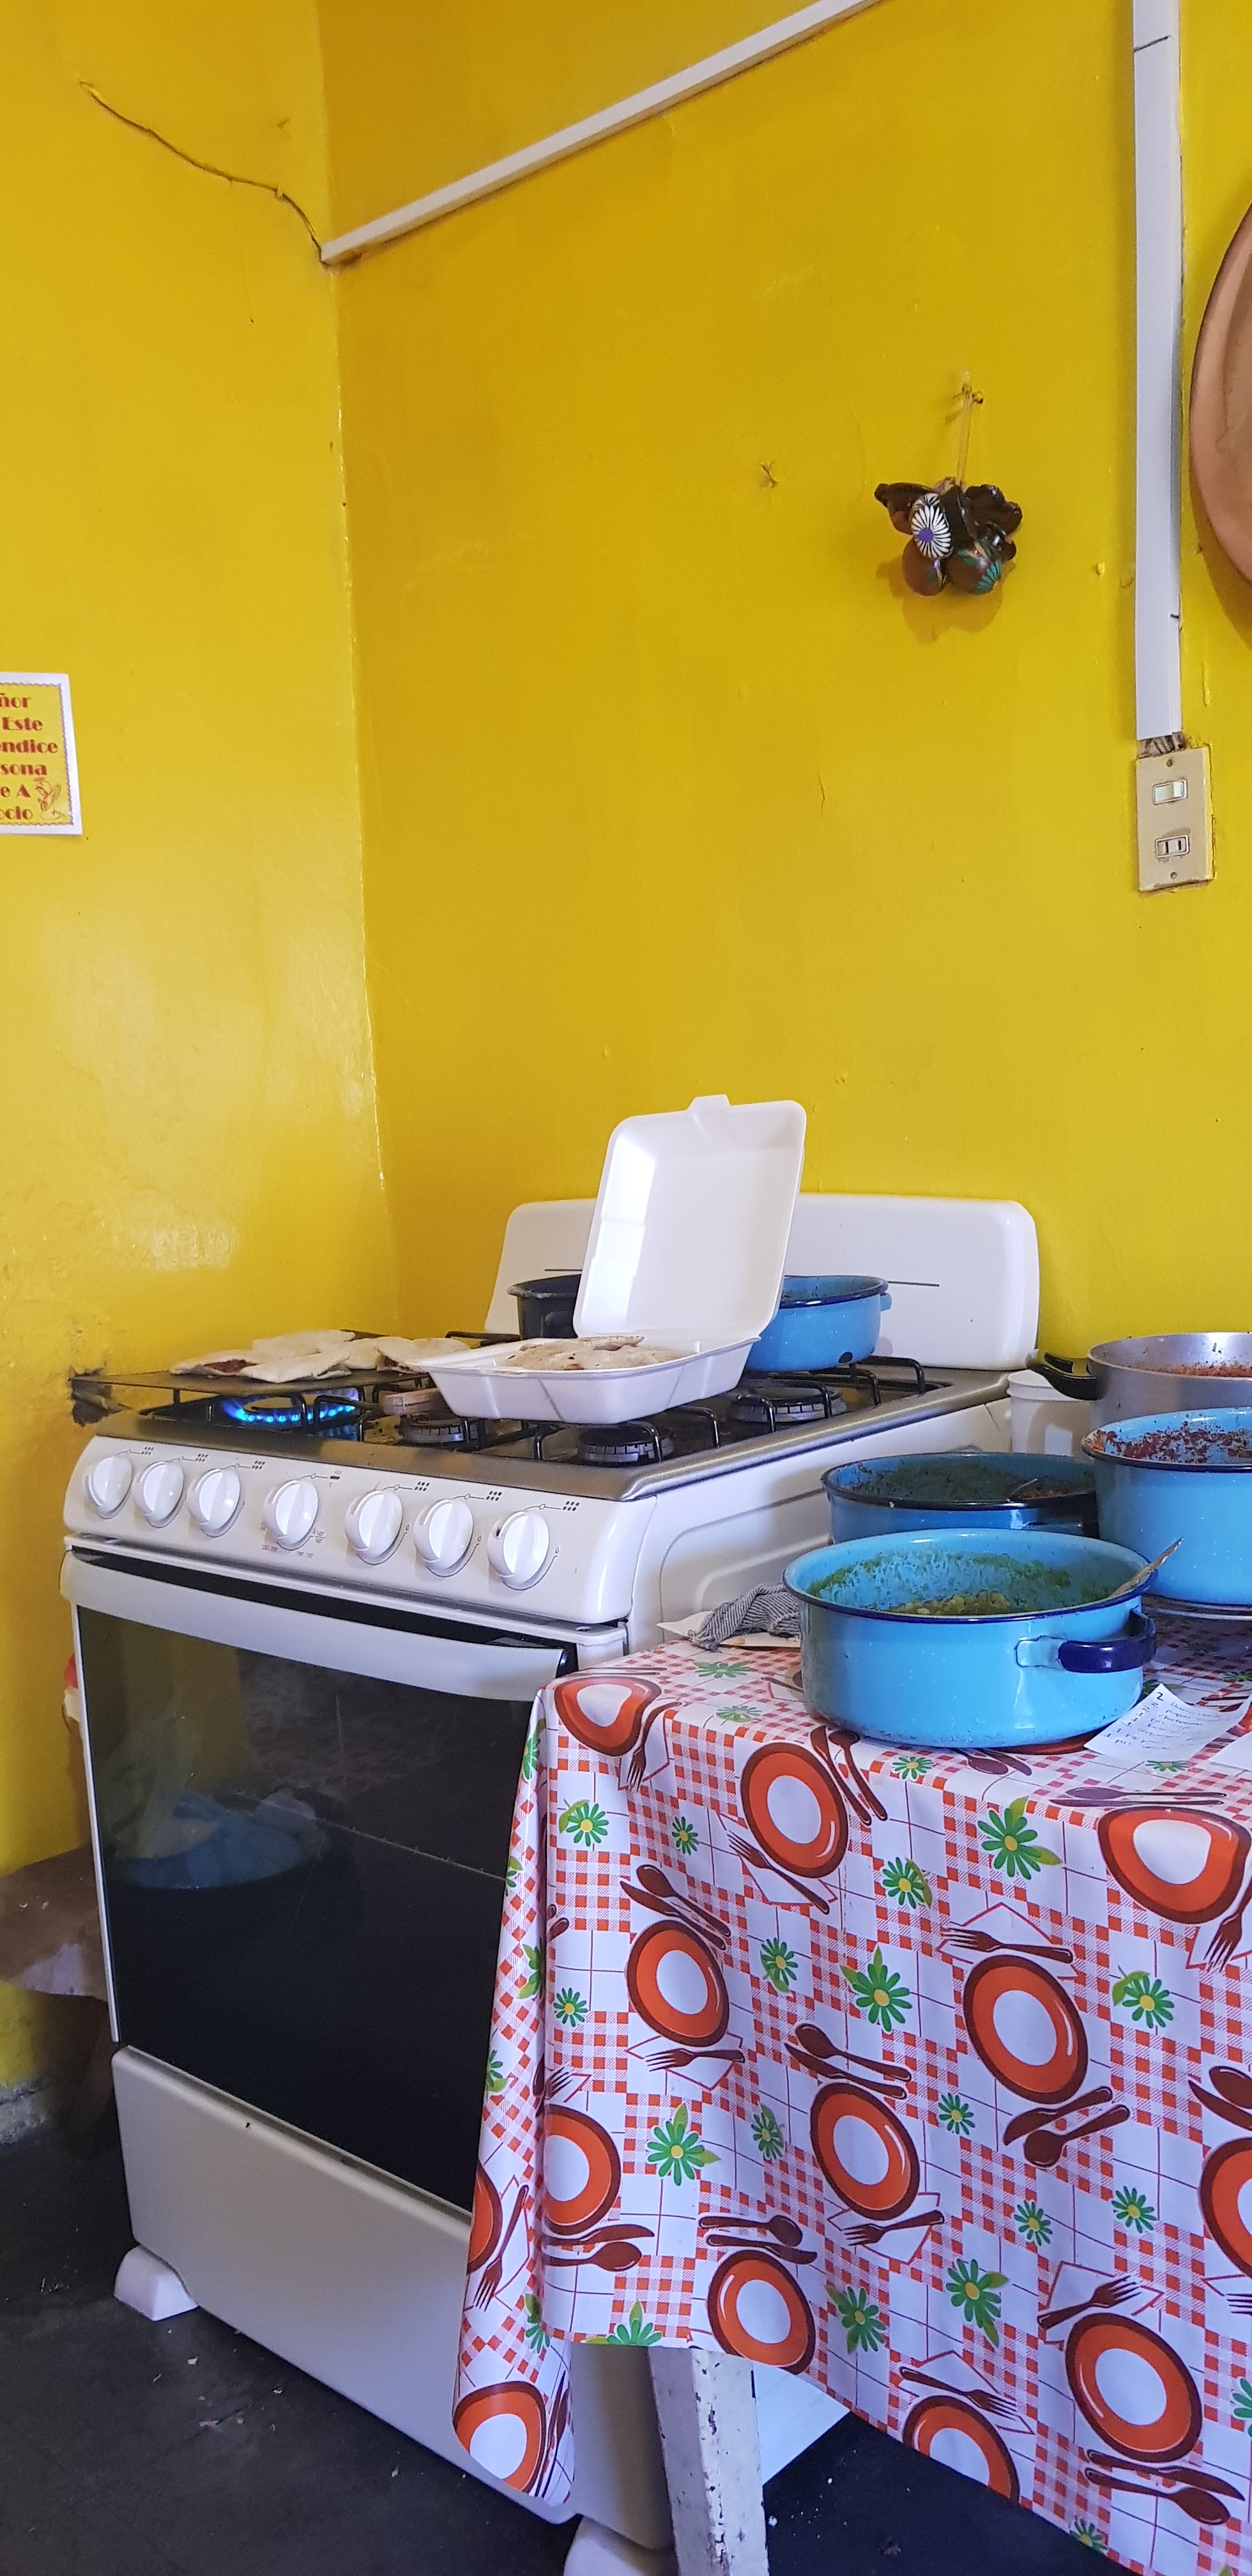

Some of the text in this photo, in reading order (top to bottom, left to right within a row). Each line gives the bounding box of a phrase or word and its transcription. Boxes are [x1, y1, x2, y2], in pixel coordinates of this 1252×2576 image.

[2, 717, 43, 731] Este
[0, 739, 58, 753] ndice
[0, 764, 47, 775] sona
[16, 784, 31, 797] A
[1156, 1692, 1164, 1701] 2
